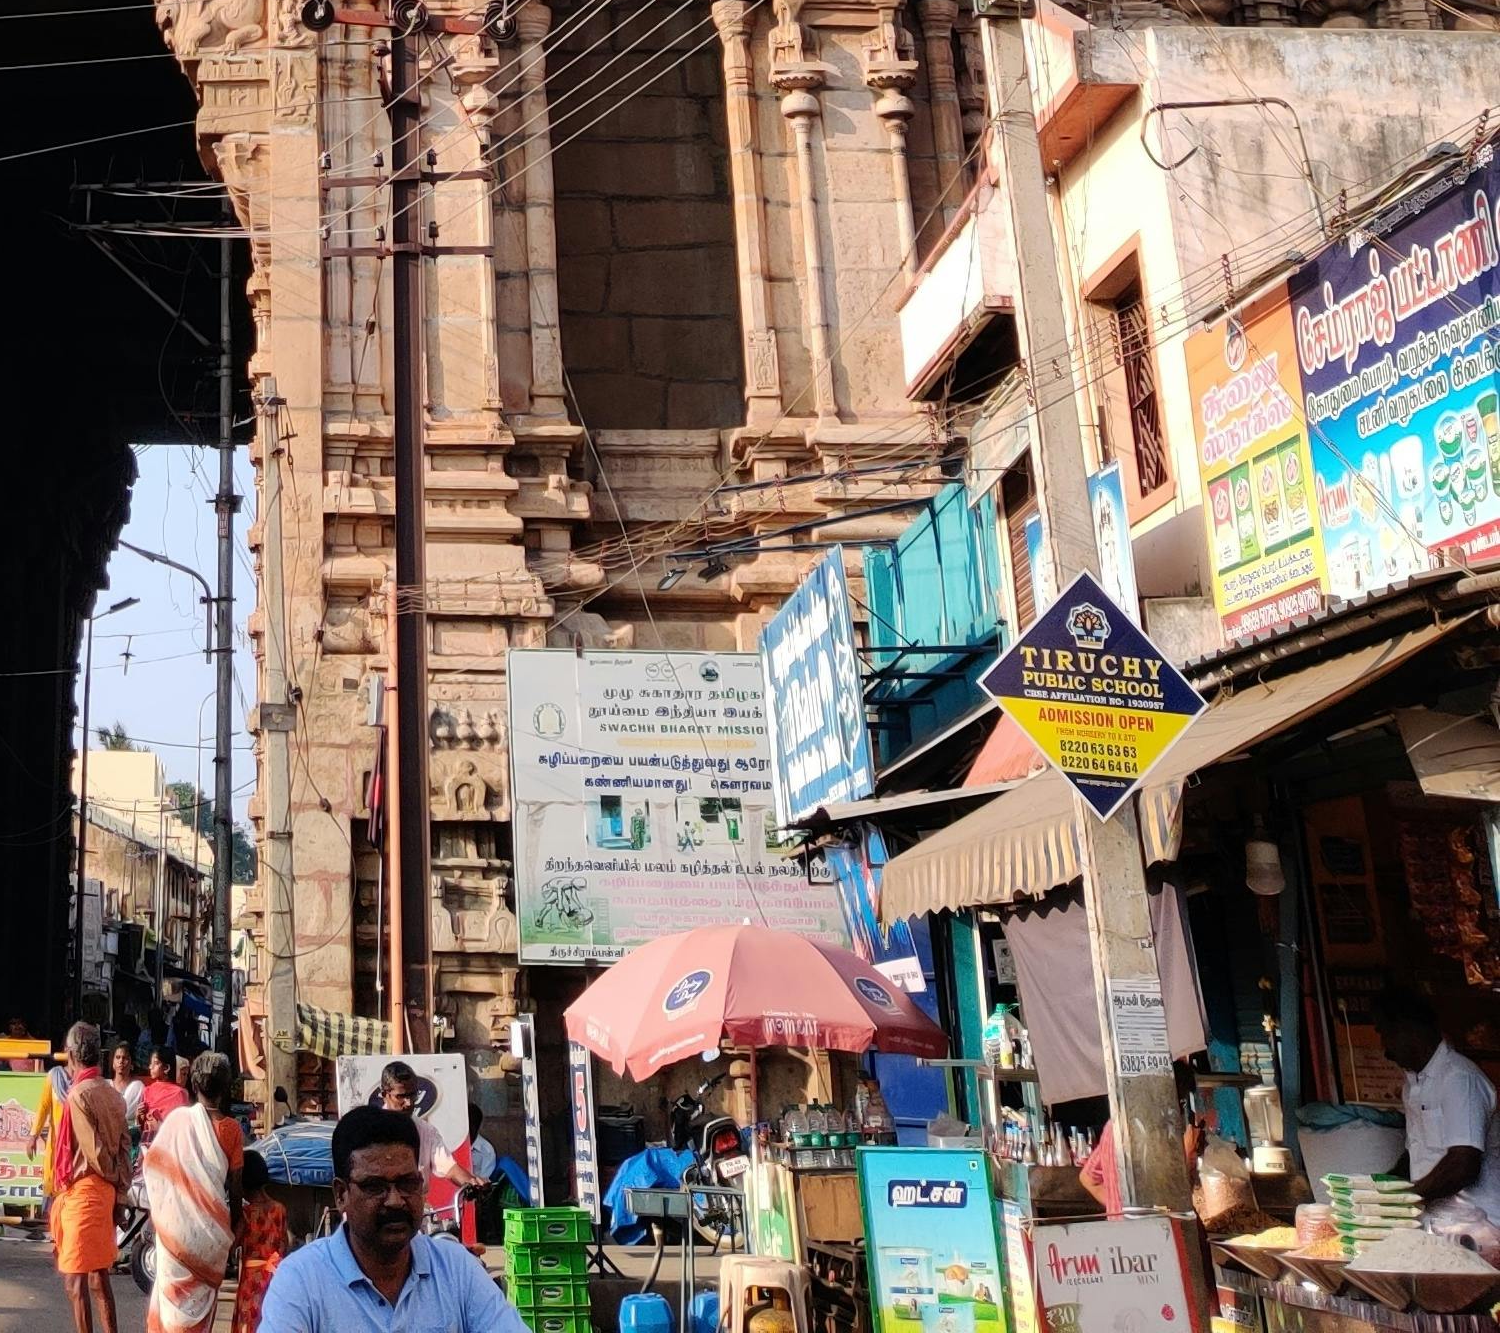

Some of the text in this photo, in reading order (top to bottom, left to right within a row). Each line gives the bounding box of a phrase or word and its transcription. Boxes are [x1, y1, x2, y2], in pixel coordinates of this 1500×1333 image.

[1020, 645, 1163, 680] TIRUCHY
[1022, 670, 1164, 699] PUBLIC SCHOOL
[1050, 690, 1107, 705] AFFILIATION
[722, 705, 765, 719] இயக்
[1038, 707, 1155, 733] ADMISSION OPEN
[600, 724, 655, 733] SWACHH
[660, 724, 713, 735] BHARAT
[1060, 739, 1089, 754] 8220
[734, 756, 771, 770] ஆரோ
[1061, 755, 1090, 769] 8220
[891, 1178, 965, 1209] ஹட்சன்
[1046, 1242, 1158, 1285] Arun ibar
